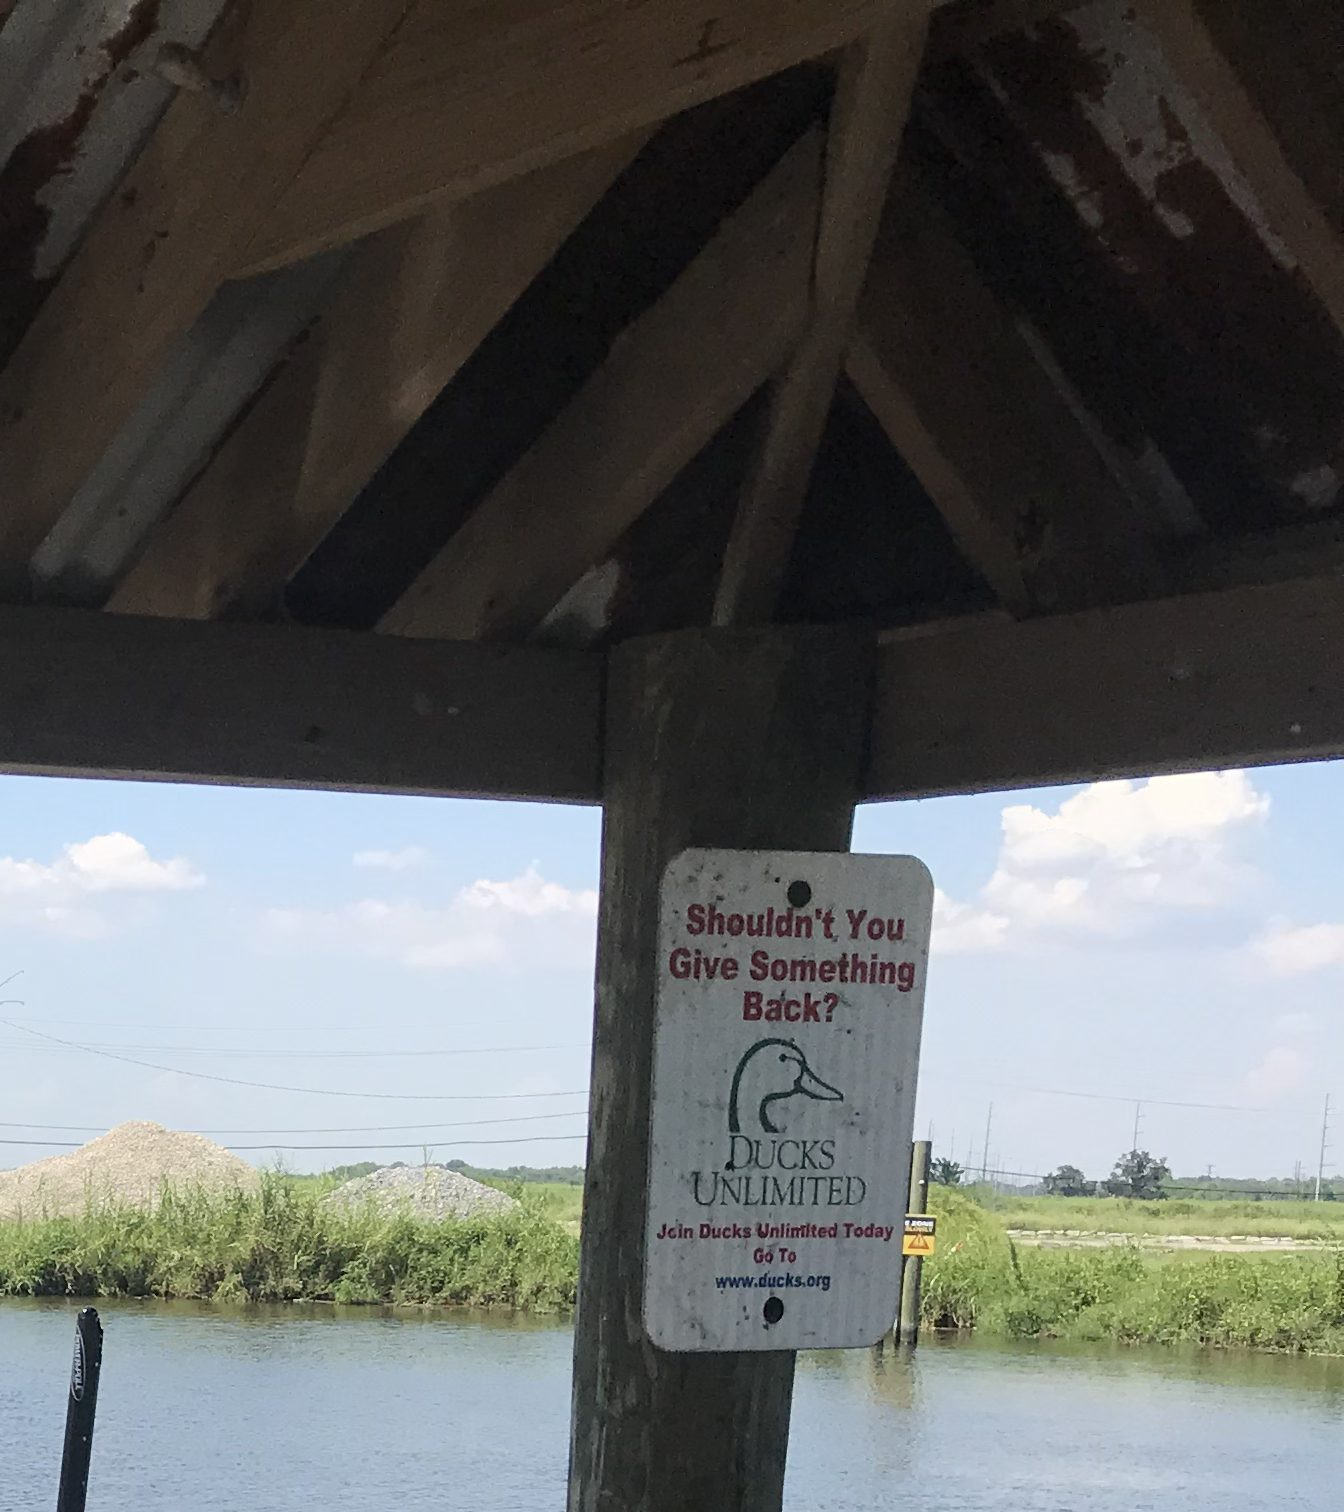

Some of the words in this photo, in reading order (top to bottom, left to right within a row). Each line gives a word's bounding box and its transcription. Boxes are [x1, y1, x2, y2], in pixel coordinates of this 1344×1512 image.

[686, 903, 835, 939] Shouldn't
[846, 909, 905, 941] You
[669, 947, 739, 981] Give
[749, 949, 916, 993] Something
[742, 990, 840, 1023] Back?
[726, 1134, 836, 1171] DUCKS
[692, 1171, 867, 1207] UNLIMITED
[657, 1223, 694, 1240] Join
[699, 1223, 752, 1239] Ducks
[757, 1222, 838, 1240] Unlimited
[843, 1222, 894, 1242] Today
[753, 1247, 774, 1264] Go
[778, 1247, 797, 1263] To
[715, 1272, 831, 1291] www.ducks.org
